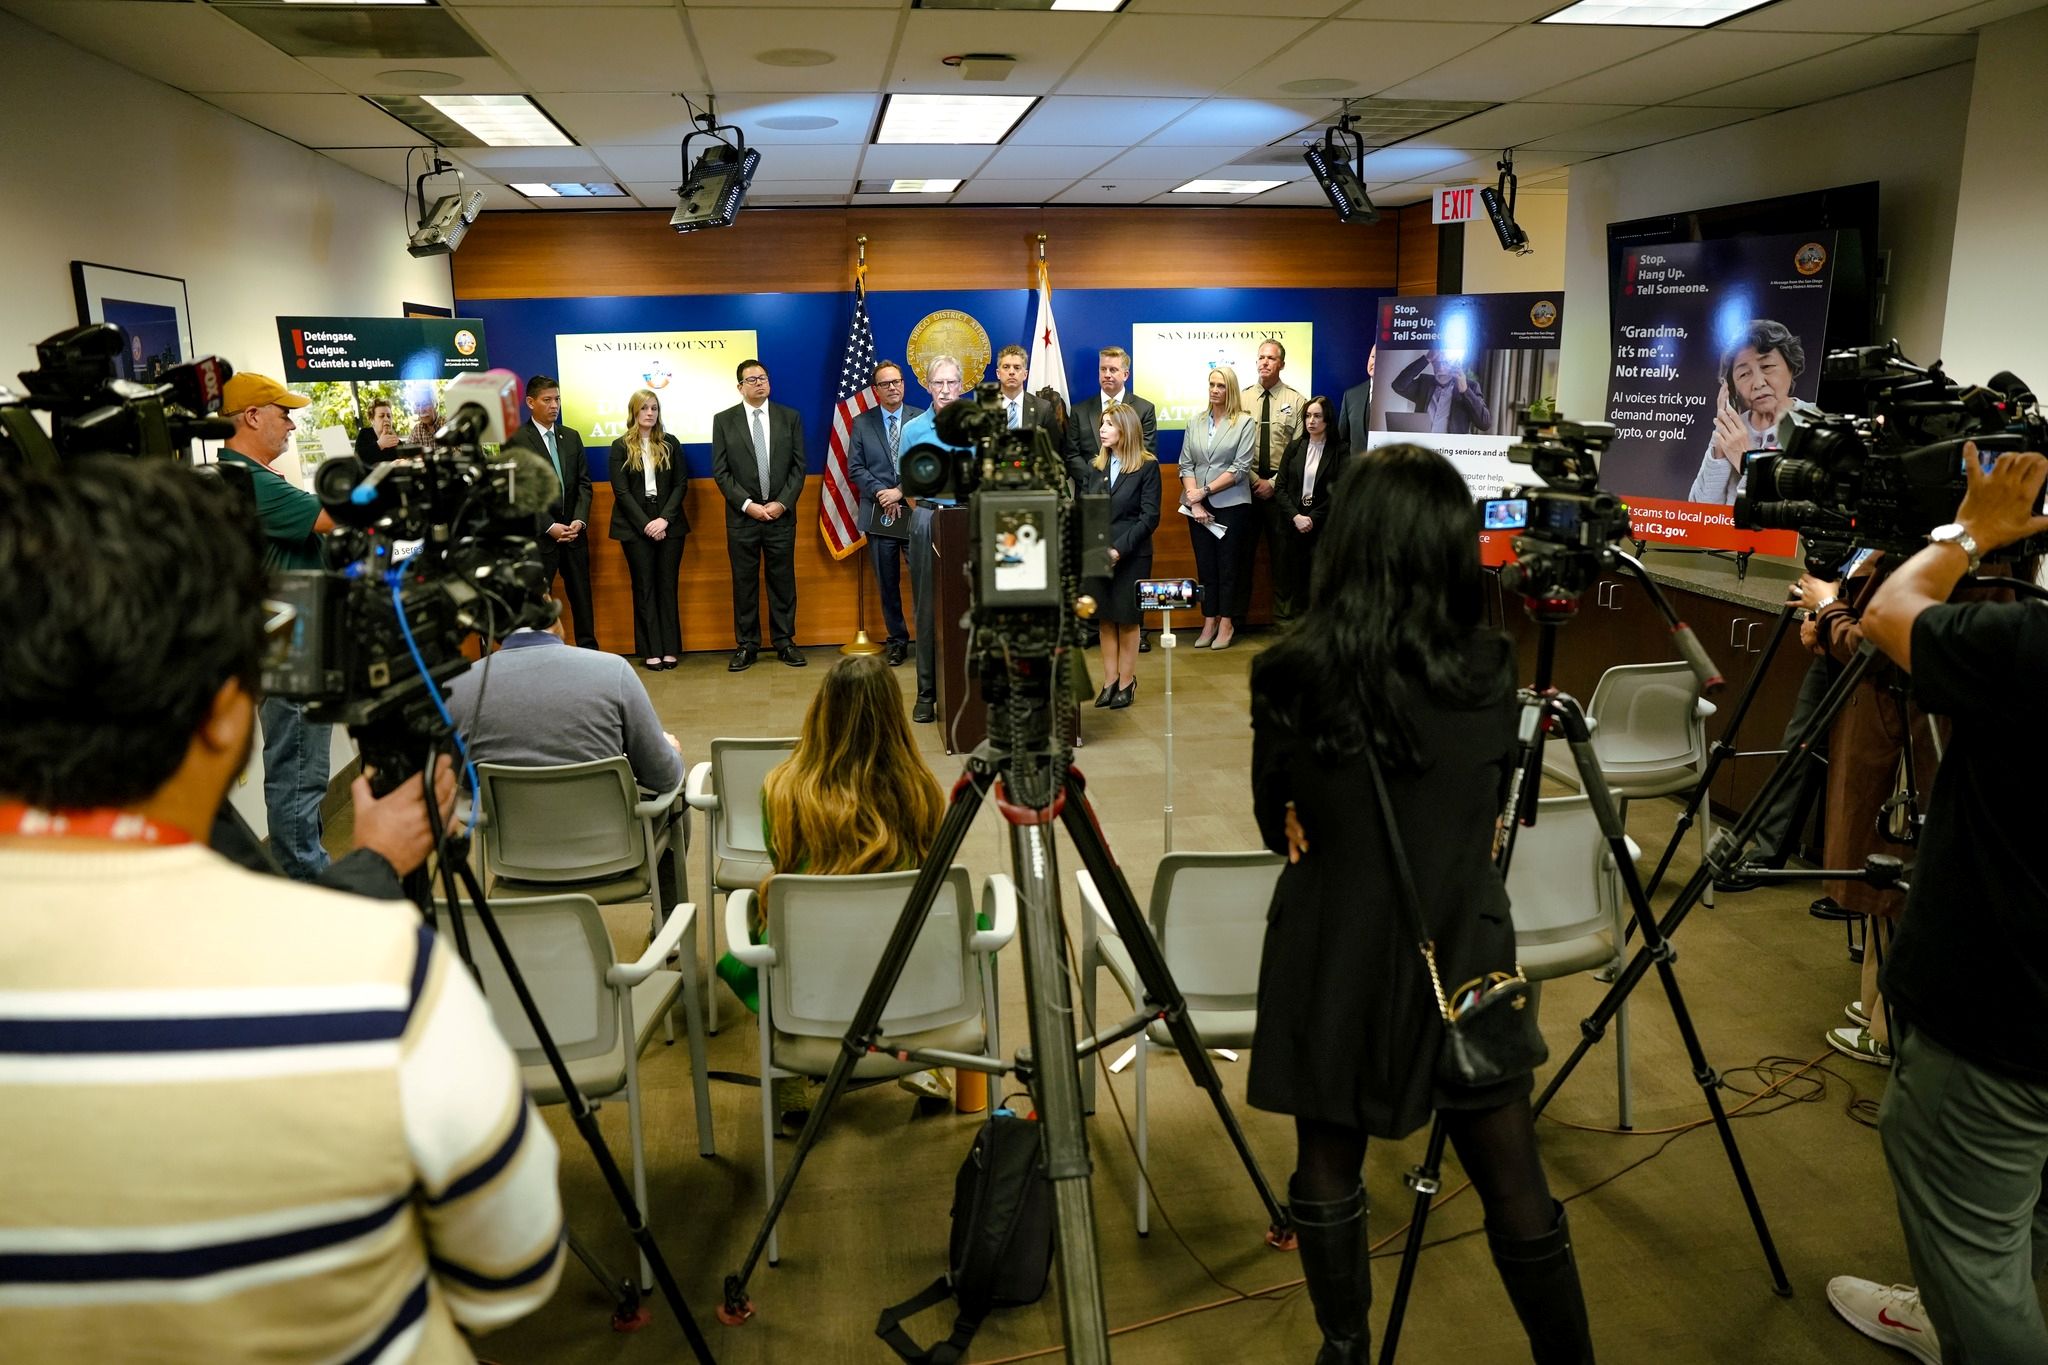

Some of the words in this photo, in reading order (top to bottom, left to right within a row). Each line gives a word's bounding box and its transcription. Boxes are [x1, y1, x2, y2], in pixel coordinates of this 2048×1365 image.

[1441, 189, 1474, 220] EXIT
[1640, 254, 1667, 266] Stop.
[1638, 270, 1665, 281] Hang
[1667, 268, 1685, 280] Up.
[1637, 284, 1655, 295] Tell
[1656, 284, 1709, 295] Someone.
[1394, 305, 1419, 316] Stop.
[1393, 318, 1418, 329] Hang
[1420, 317, 1437, 329] Up.
[303, 331, 357, 343] Deténgase.
[908, 344, 916, 361] SAN
[912, 318, 931, 341] DIEGO
[933, 311, 967, 321] DISTRICT
[969, 321, 990, 359] ATTORNEY
[1158, 331, 1183, 340] SAN
[1188, 331, 1229, 340] DIEGO
[1232, 331, 1286, 340] COUNTY
[1393, 331, 1409, 341] Tell
[1620, 324, 1688, 339] “Grandma,
[306, 345, 348, 357] Cuelgue.
[584, 342, 612, 352] SAN
[617, 341, 663, 351] DIEGO
[667, 339, 727, 349] COUNTY
[1617, 345, 1635, 358] it’s
[308, 358, 350, 368] Cuéntele
[358, 358, 394, 370] alguien.
[1615, 365, 1638, 378] Not
[1640, 364, 1680, 381] really.
[200, 360, 219, 401] FOX
[207, 399, 220, 412] 5
[1613, 391, 1623, 403] AI
[1625, 392, 1657, 404] voices
[1659, 392, 1683, 405] trick
[1684, 395, 1706, 408] you
[1610, 408, 1654, 421] demand
[1655, 412, 1695, 426] money,
[1615, 427, 1643, 440] rypto,
[1645, 429, 1657, 438] or
[1659, 427, 1687, 441] gold.
[1454, 448, 1481, 456] seniors
[1482, 449, 1497, 457] and
[1487, 473, 1505, 482] help,
[1633, 507, 1662, 519] scams
[1665, 509, 1676, 520] to
[1677, 510, 1702, 523] local
[1703, 514, 1736, 526] police
[1634, 523, 1644, 533] at
[1645, 522, 1688, 538] IC3.gov.
